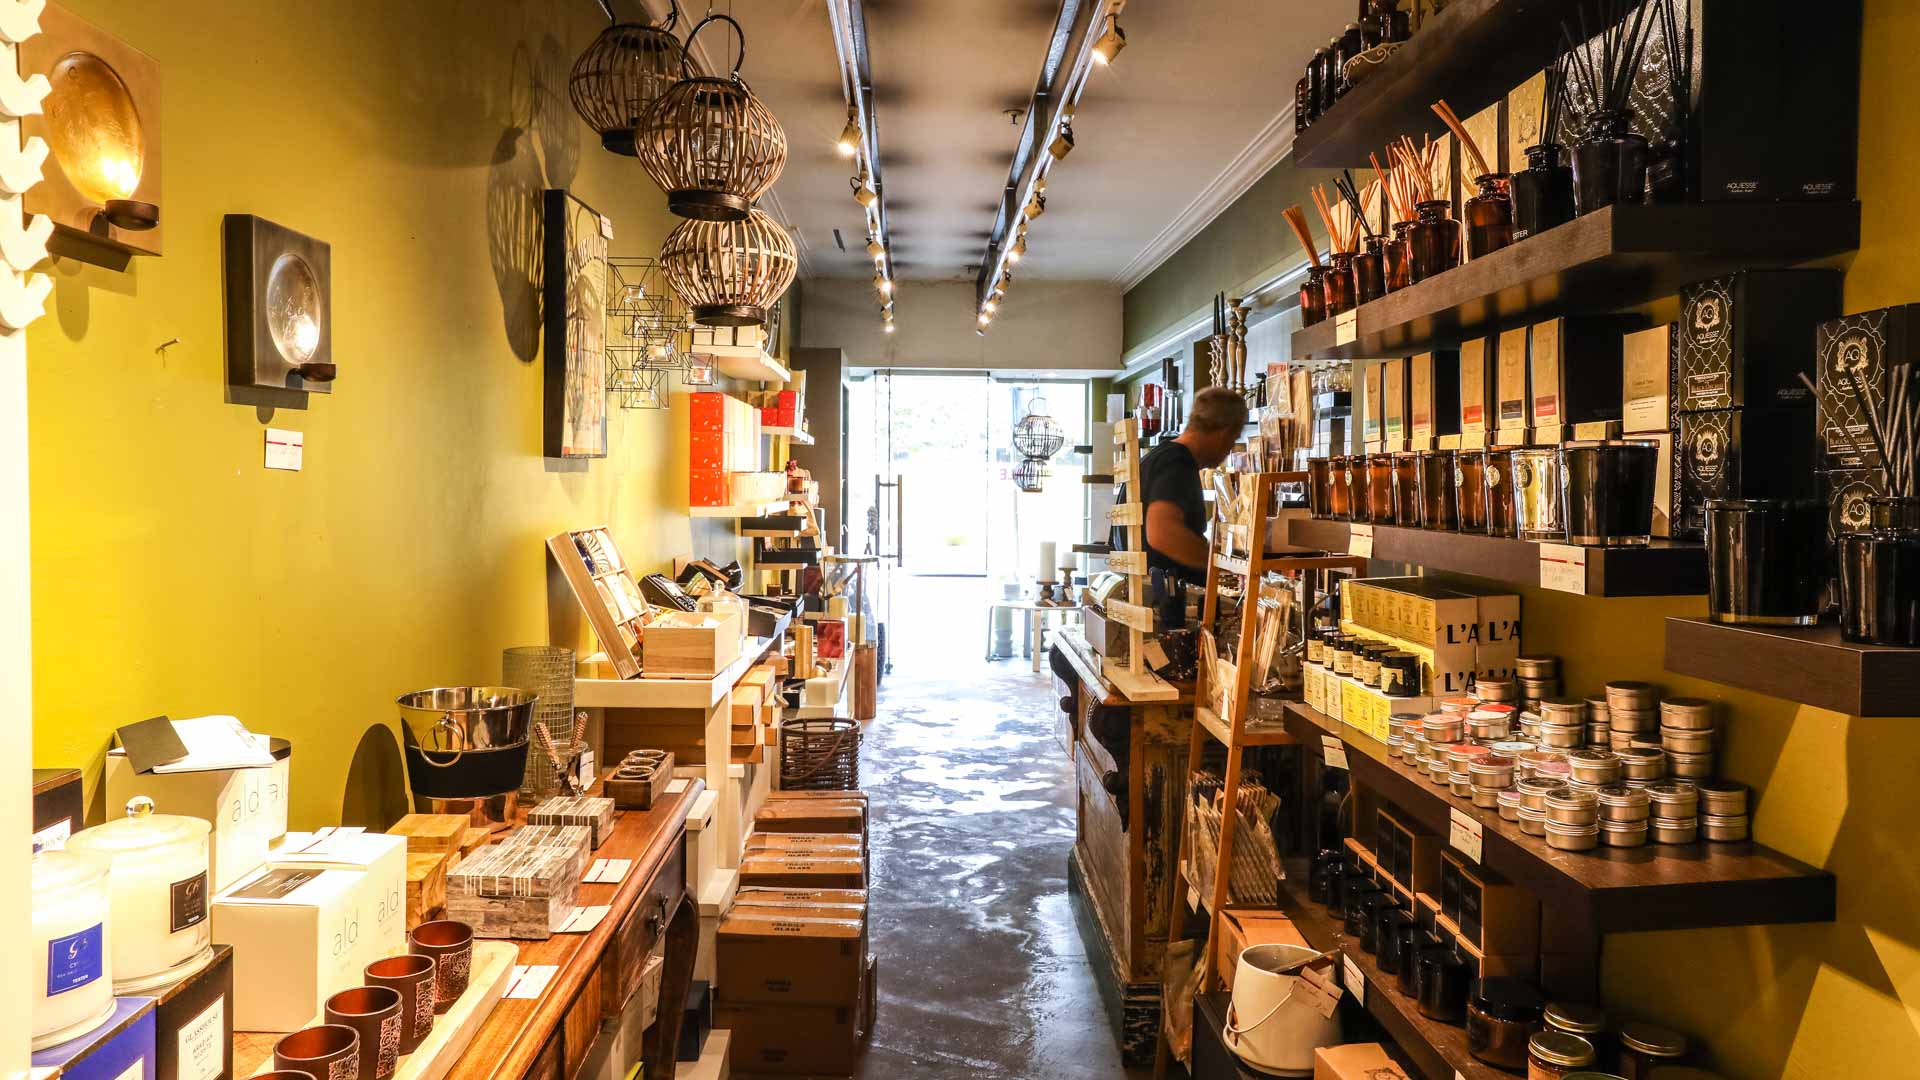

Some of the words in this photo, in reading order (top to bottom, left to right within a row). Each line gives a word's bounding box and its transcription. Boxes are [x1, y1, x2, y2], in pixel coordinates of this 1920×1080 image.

[1846, 349, 1860, 361] AQ
[1702, 442, 1713, 452] AQ
[1849, 504, 1864, 516] AQ
[378, 880, 398, 922] ald
[332, 907, 358, 956] ald
